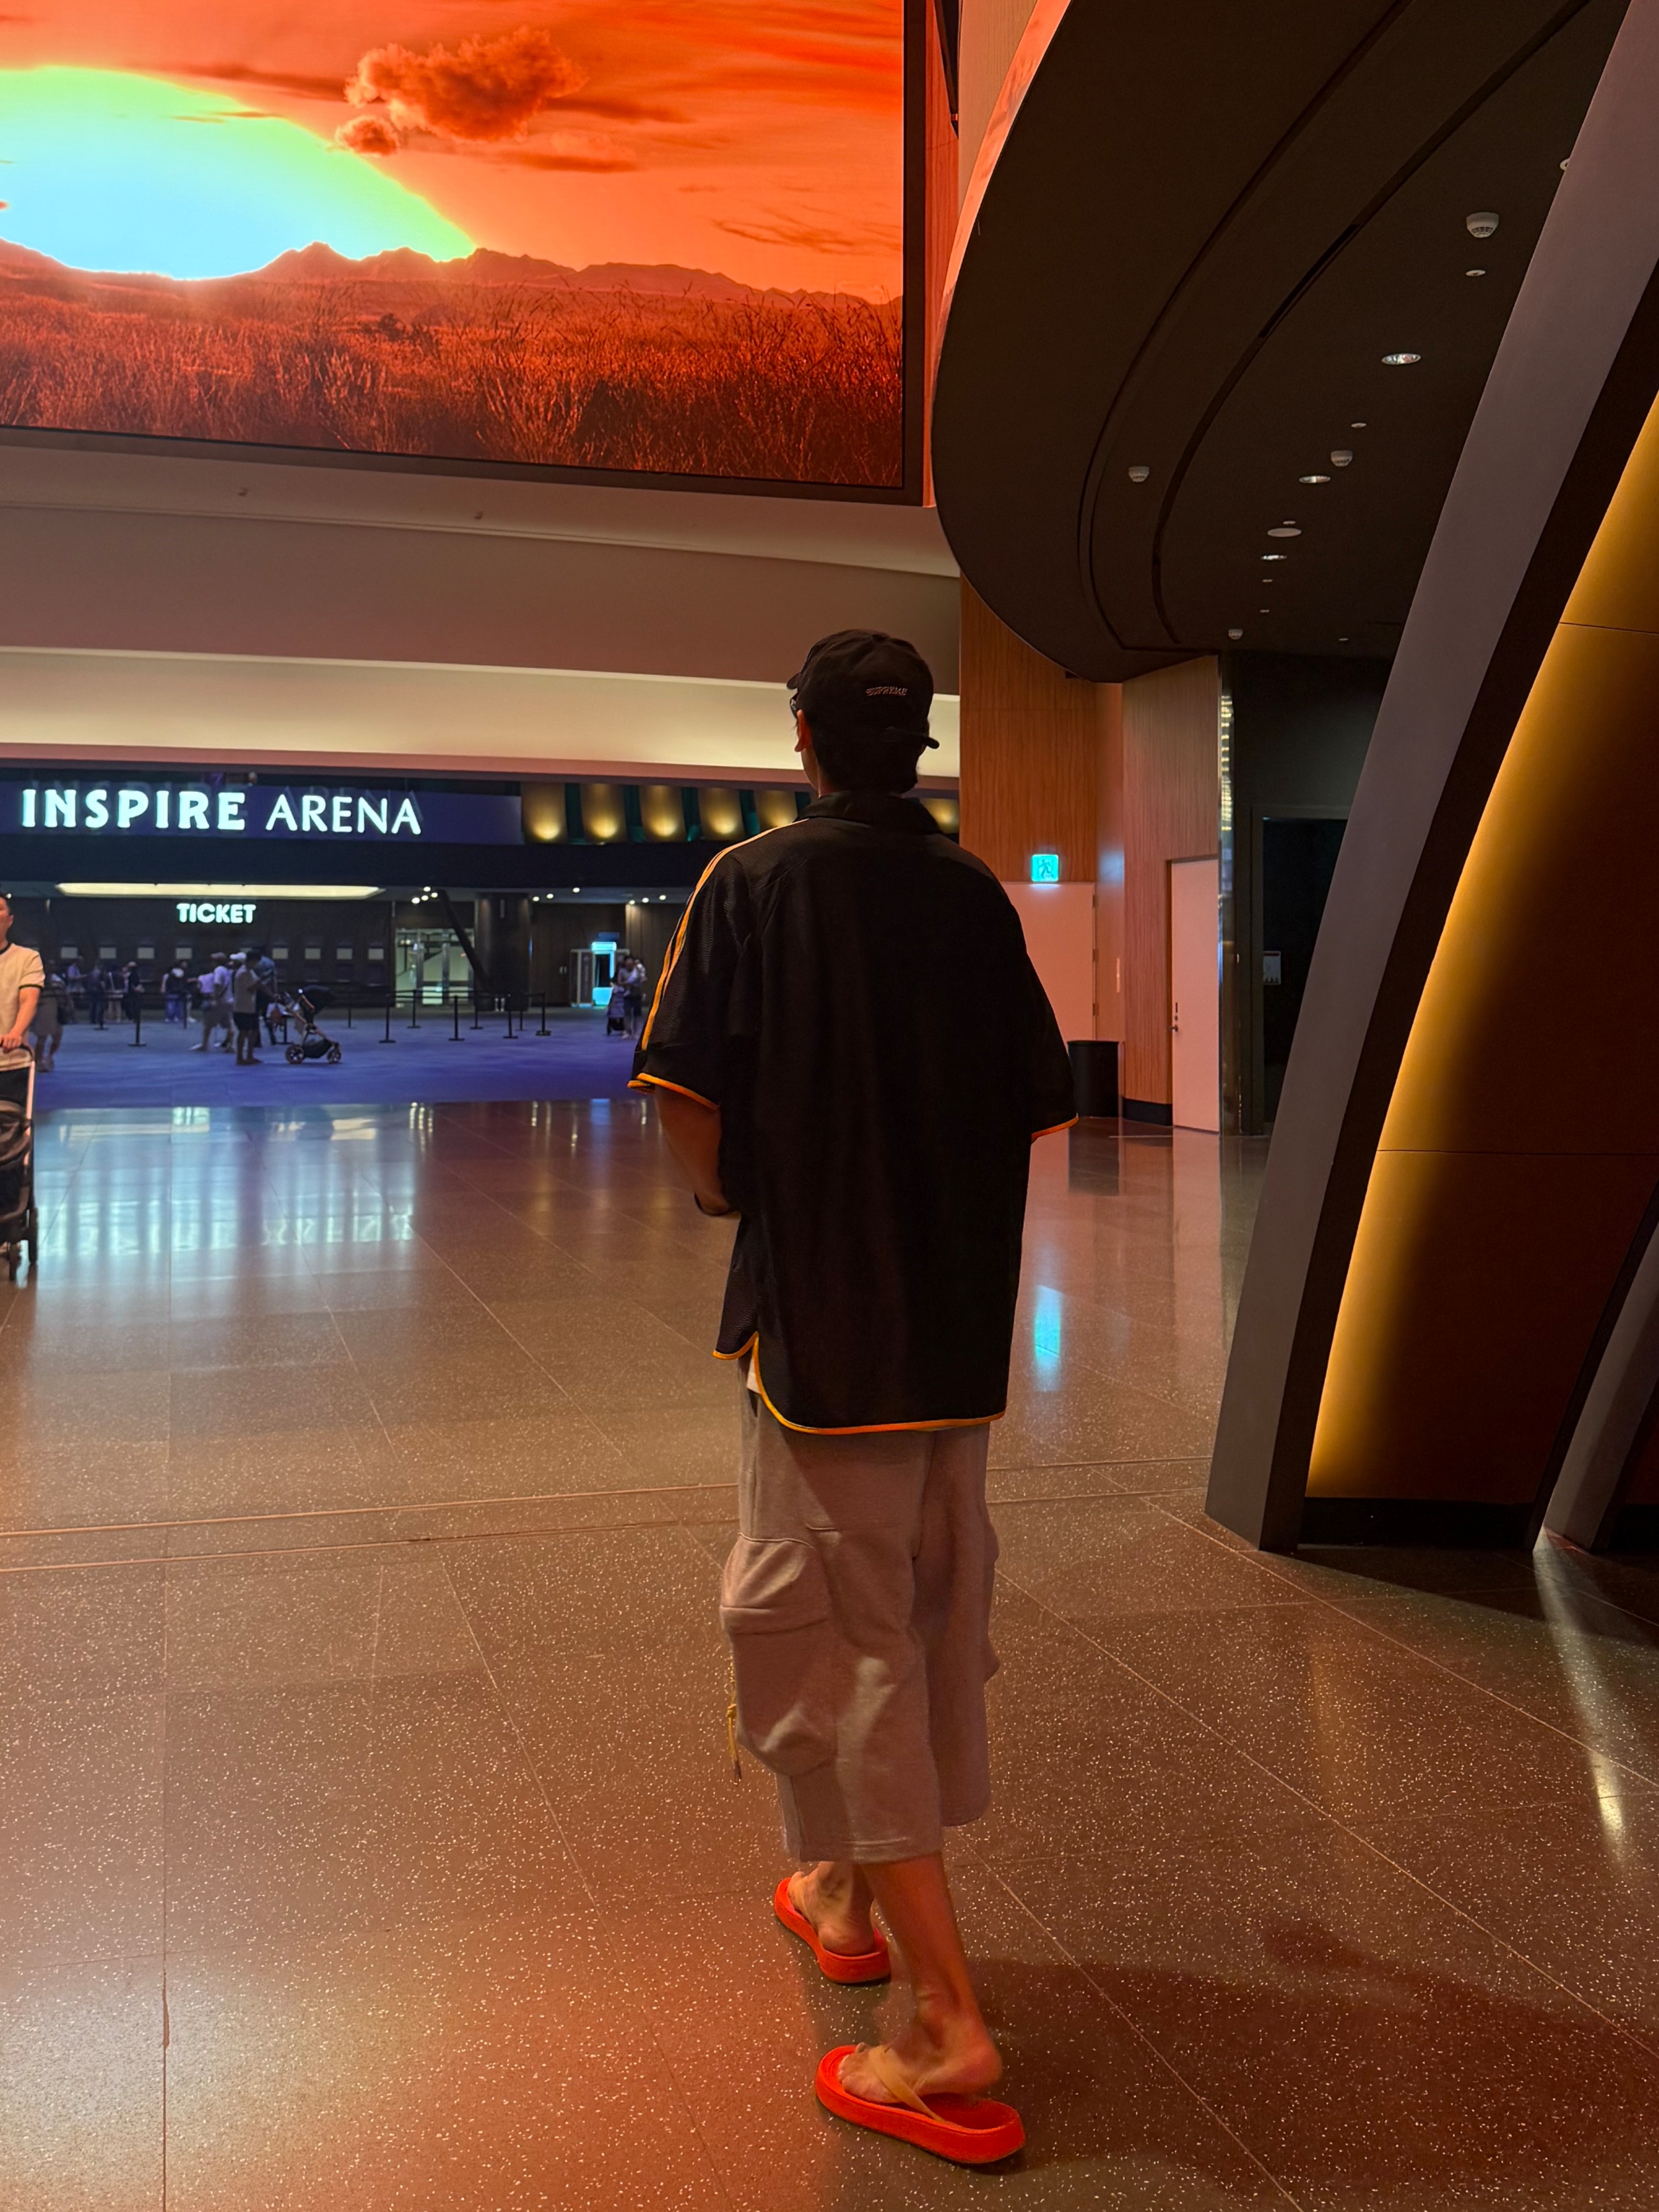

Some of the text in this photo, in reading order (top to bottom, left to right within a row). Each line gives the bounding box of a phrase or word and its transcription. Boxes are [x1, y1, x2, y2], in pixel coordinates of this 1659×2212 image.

[22, 789, 422, 835] INSPIRE ARENA
[176, 903, 257, 924] TICKET
